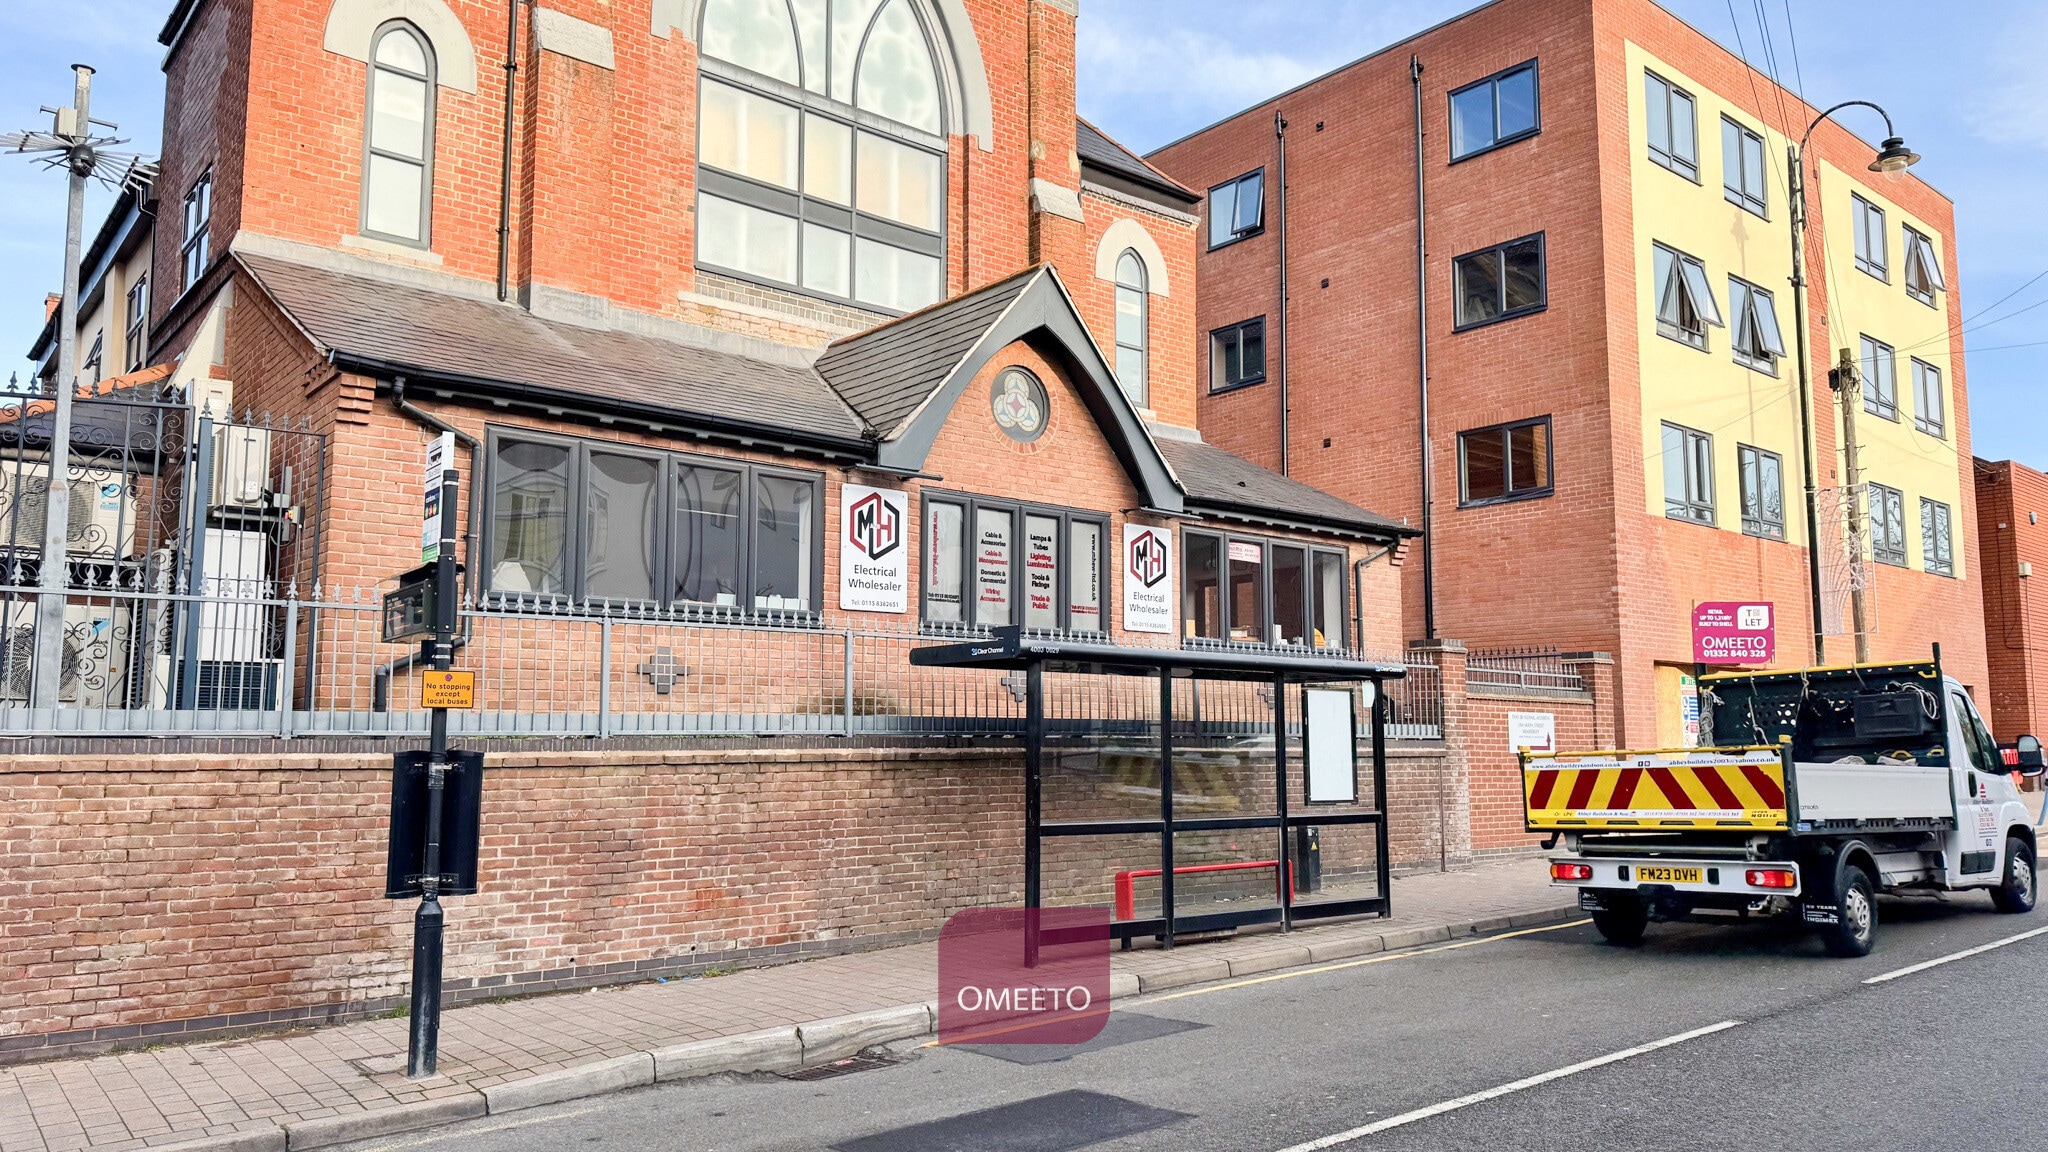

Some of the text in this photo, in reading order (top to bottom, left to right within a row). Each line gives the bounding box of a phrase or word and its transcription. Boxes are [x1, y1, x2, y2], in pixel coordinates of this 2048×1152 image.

[1030, 534, 1046, 542] Lamps
[980, 539, 1006, 547] Accessories
[978, 557, 1008, 565] Management
[1030, 552, 1052, 562] Lighting
[1026, 560, 1055, 570] Luminaires
[854, 564, 896, 577] Electrical
[848, 578, 902, 592] Wholesaler
[1032, 581, 1050, 590] Fixings
[985, 588, 1000, 596] Wiring
[1030, 594, 1045, 602] Trade
[1134, 592, 1164, 602] Electrical
[1032, 602, 1049, 610] Public
[1129, 604, 1168, 615] Wholesaler
[1746, 618, 1762, 626] LET
[1702, 636, 1766, 649] OMEETO
[988, 646, 1004, 654] Channel
[1640, 868, 1697, 881] FM23 DVH
